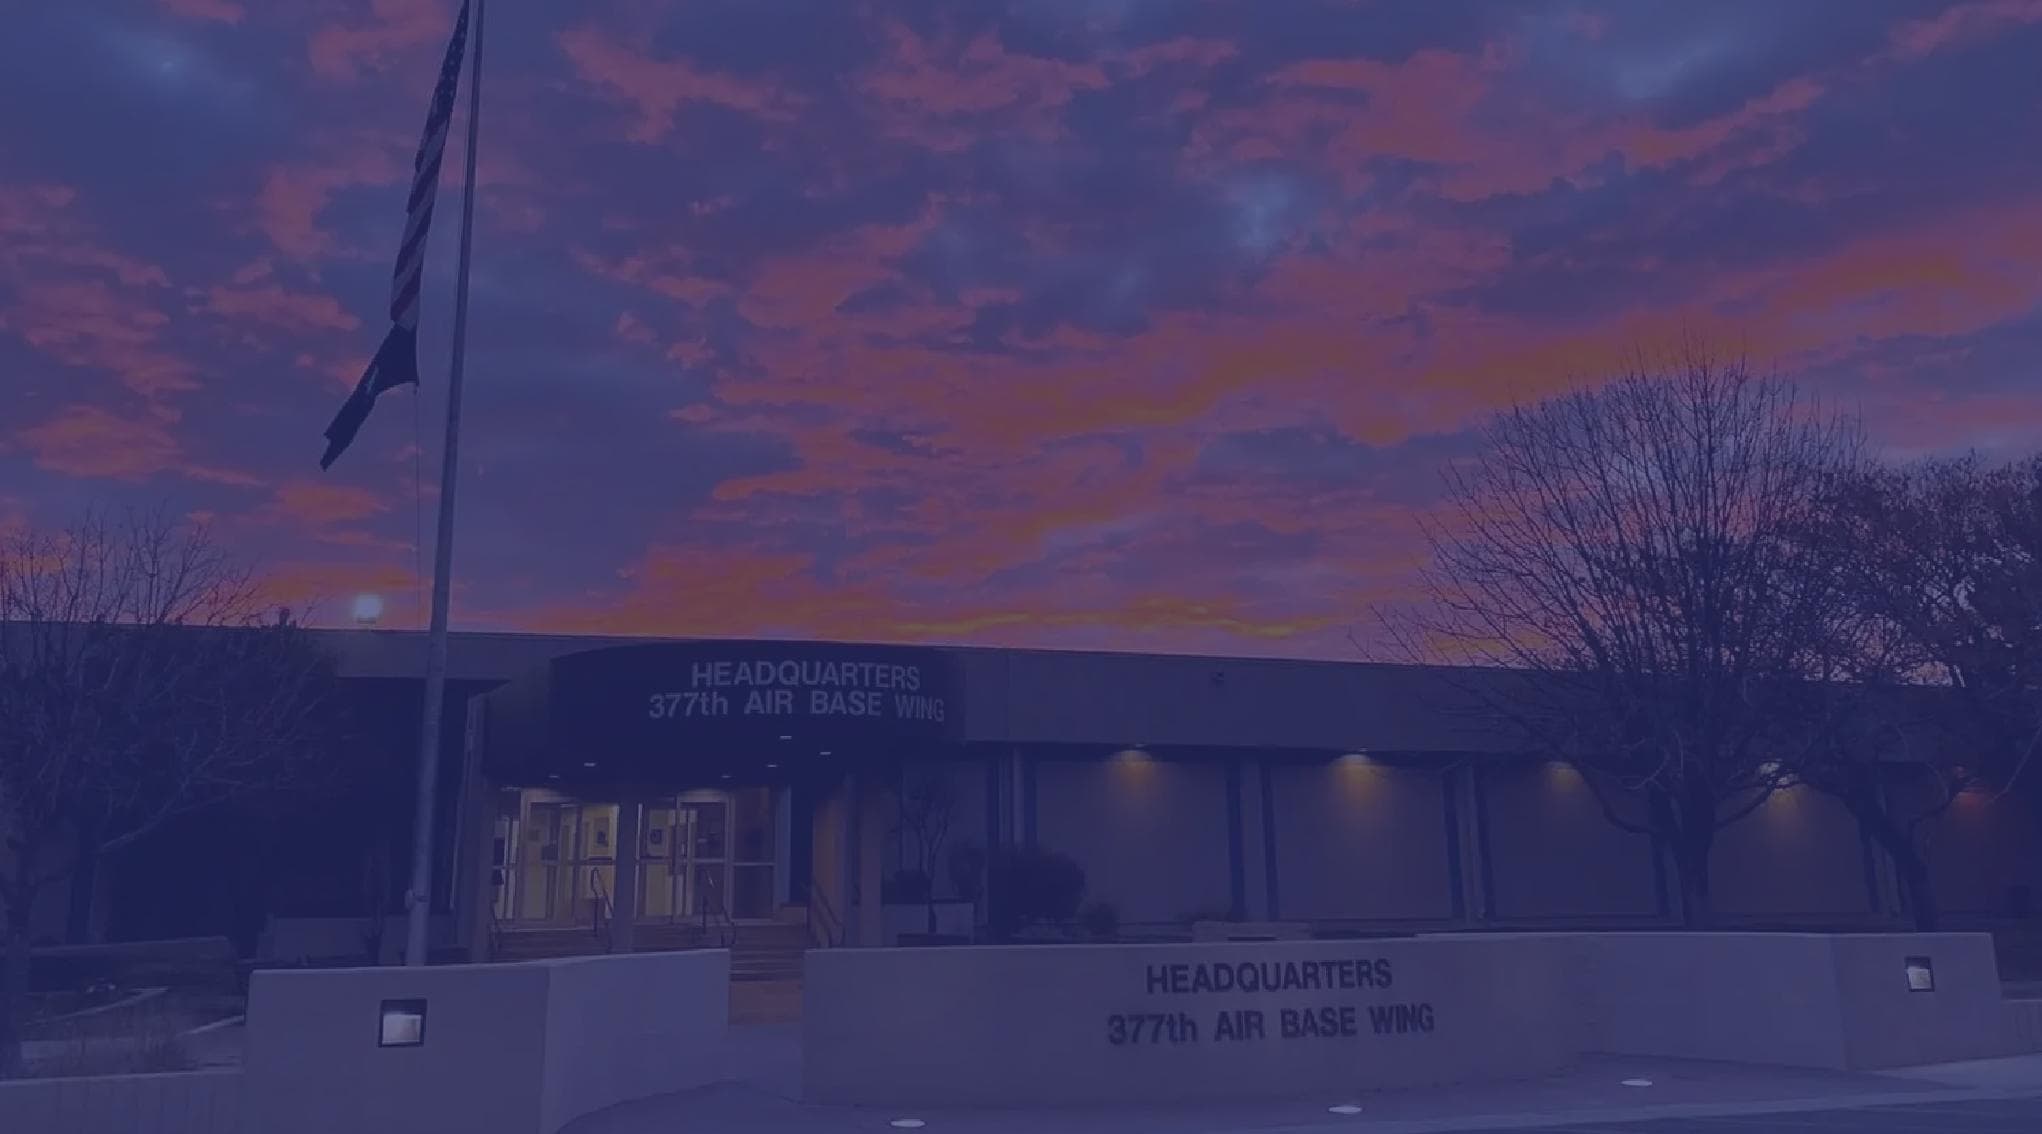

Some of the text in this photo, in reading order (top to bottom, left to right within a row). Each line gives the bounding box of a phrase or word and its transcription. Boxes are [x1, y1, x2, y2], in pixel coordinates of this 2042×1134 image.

[691, 660, 921, 690] HEADQUARTERS
[648, 690, 945, 722] 377th AIR BASE WING
[1146, 958, 1393, 994] HEADQUARTERS
[1107, 1002, 1435, 1044] 377th AIR BASE WING
